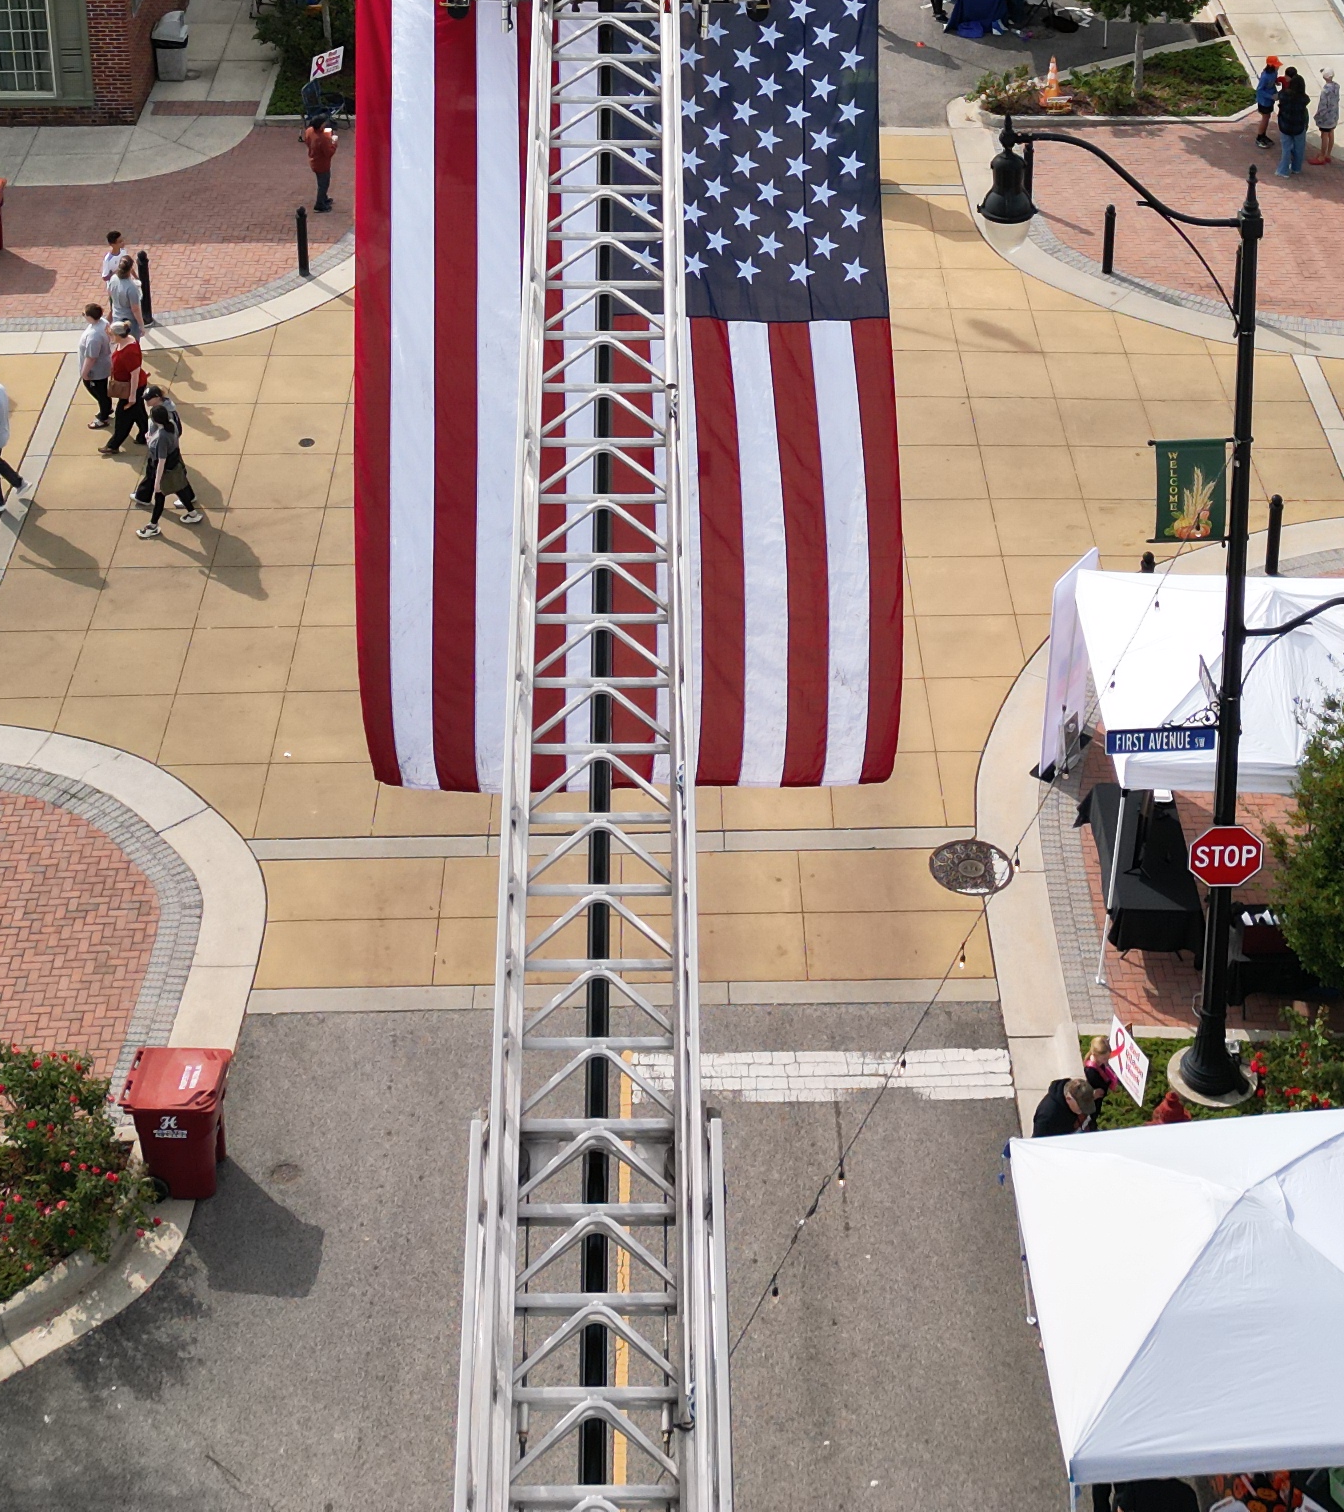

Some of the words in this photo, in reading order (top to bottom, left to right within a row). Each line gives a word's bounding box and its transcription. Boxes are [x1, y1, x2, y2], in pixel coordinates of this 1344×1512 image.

[1168, 451, 1179, 511] WELCOME
[1116, 732, 1144, 751] FIRST
[1149, 730, 1191, 750] AVENUE
[1195, 736, 1206, 748] SW
[1194, 845, 1257, 868] STOP
